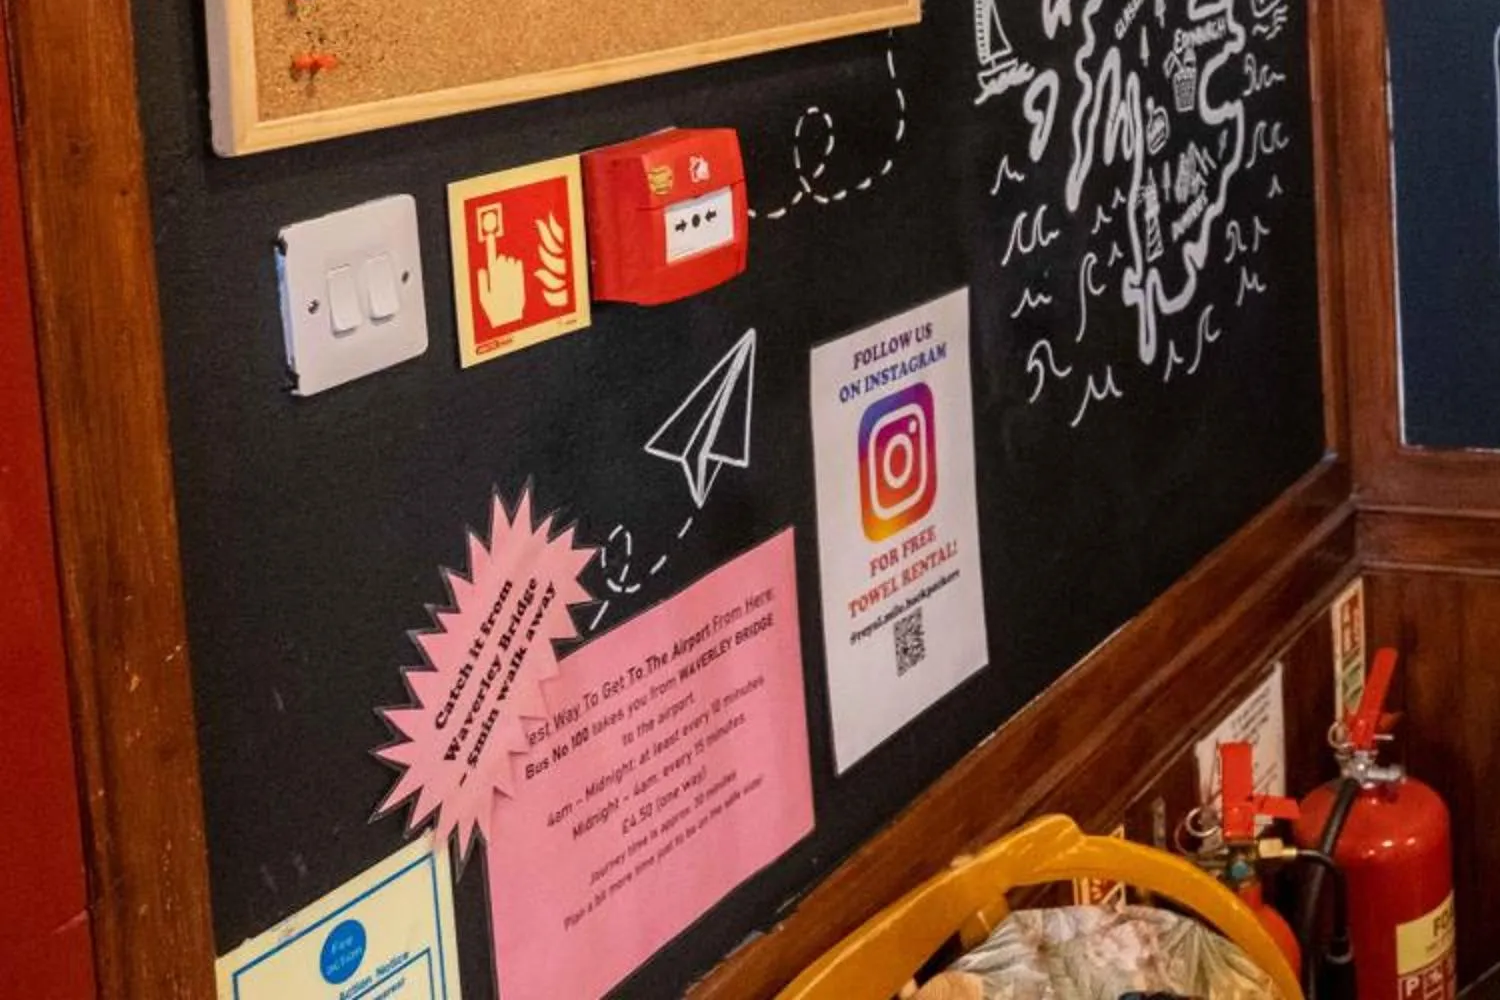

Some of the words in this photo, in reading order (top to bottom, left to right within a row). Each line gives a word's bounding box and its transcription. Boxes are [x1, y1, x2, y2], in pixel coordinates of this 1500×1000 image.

[838, 379, 862, 403] ON
[864, 342, 948, 394] INSTAGRAM
[852, 331, 912, 371] FOLLOW
[915, 322, 934, 344] US
[848, 577, 900, 619] TOWEL
[901, 540, 959, 587] RENTAL!
[869, 548, 900, 578] FOR
[902, 524, 937, 559] FREE
[434, 663, 474, 731] Catch
[468, 637, 486, 660] it
[480, 579, 513, 636] from
[443, 653, 503, 761] Waverley
[498, 577, 539, 652] Bridge
[496, 647, 529, 702] walk
[525, 580, 557, 643] away
[525, 758, 551, 781] Bus
[551, 745, 570, 765] No
[570, 727, 590, 750] 100
[592, 709, 626, 738] takes
[627, 695, 650, 718] you
[651, 675, 678, 701] from
[678, 640, 734, 684] WAVERLEY
[734, 612, 775, 648] BRIDGE
[553, 703, 582, 732] Way
[583, 692, 600, 711] To
[602, 676, 626, 700] Get
[627, 666, 645, 686] To
[645, 652, 670, 676] The
[672, 620, 712, 662] Airport
[711, 605, 743, 635] From
[547, 803, 574, 828] 4am
[638, 750, 651, 765] at
[653, 730, 680, 755] least
[682, 711, 711, 737] every
[723, 674, 765, 706] minutes
[572, 797, 620, 841] Midnight
[663, 750, 694, 778] every
[706, 712, 746, 747] minutes
[621, 731, 635, 747] to
[637, 718, 656, 738] the
[657, 692, 695, 728] airport
